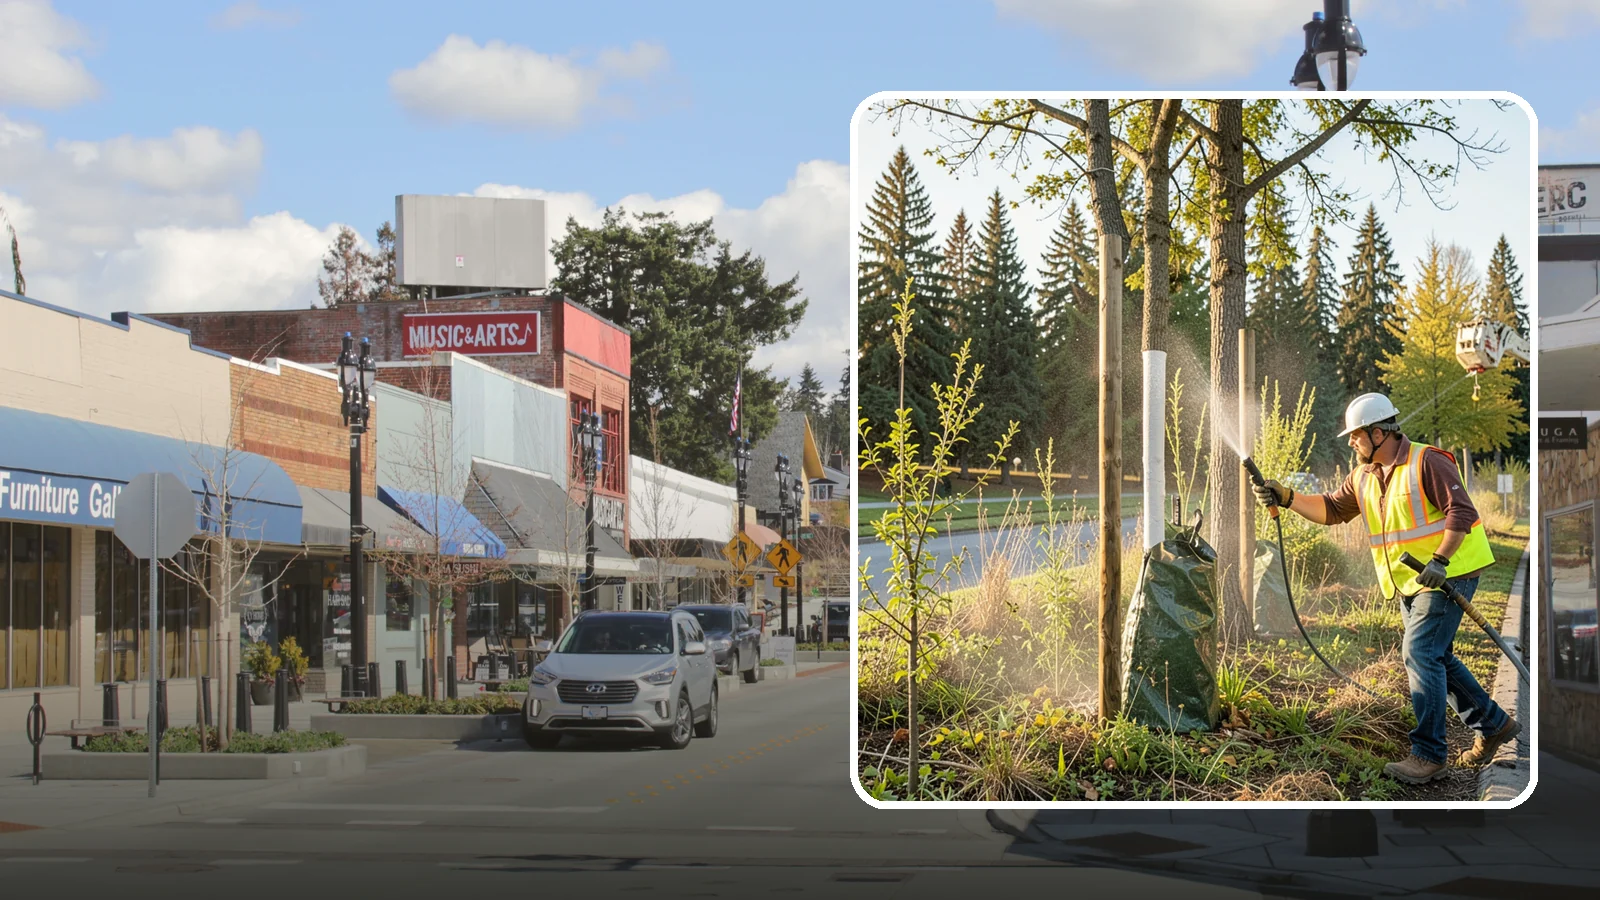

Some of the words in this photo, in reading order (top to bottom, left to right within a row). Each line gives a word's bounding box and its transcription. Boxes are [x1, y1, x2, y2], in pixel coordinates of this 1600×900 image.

[0, 471, 79, 516] Furniture
[89, 482, 122, 520] Gal
[453, 562, 479, 574] SUSHI
